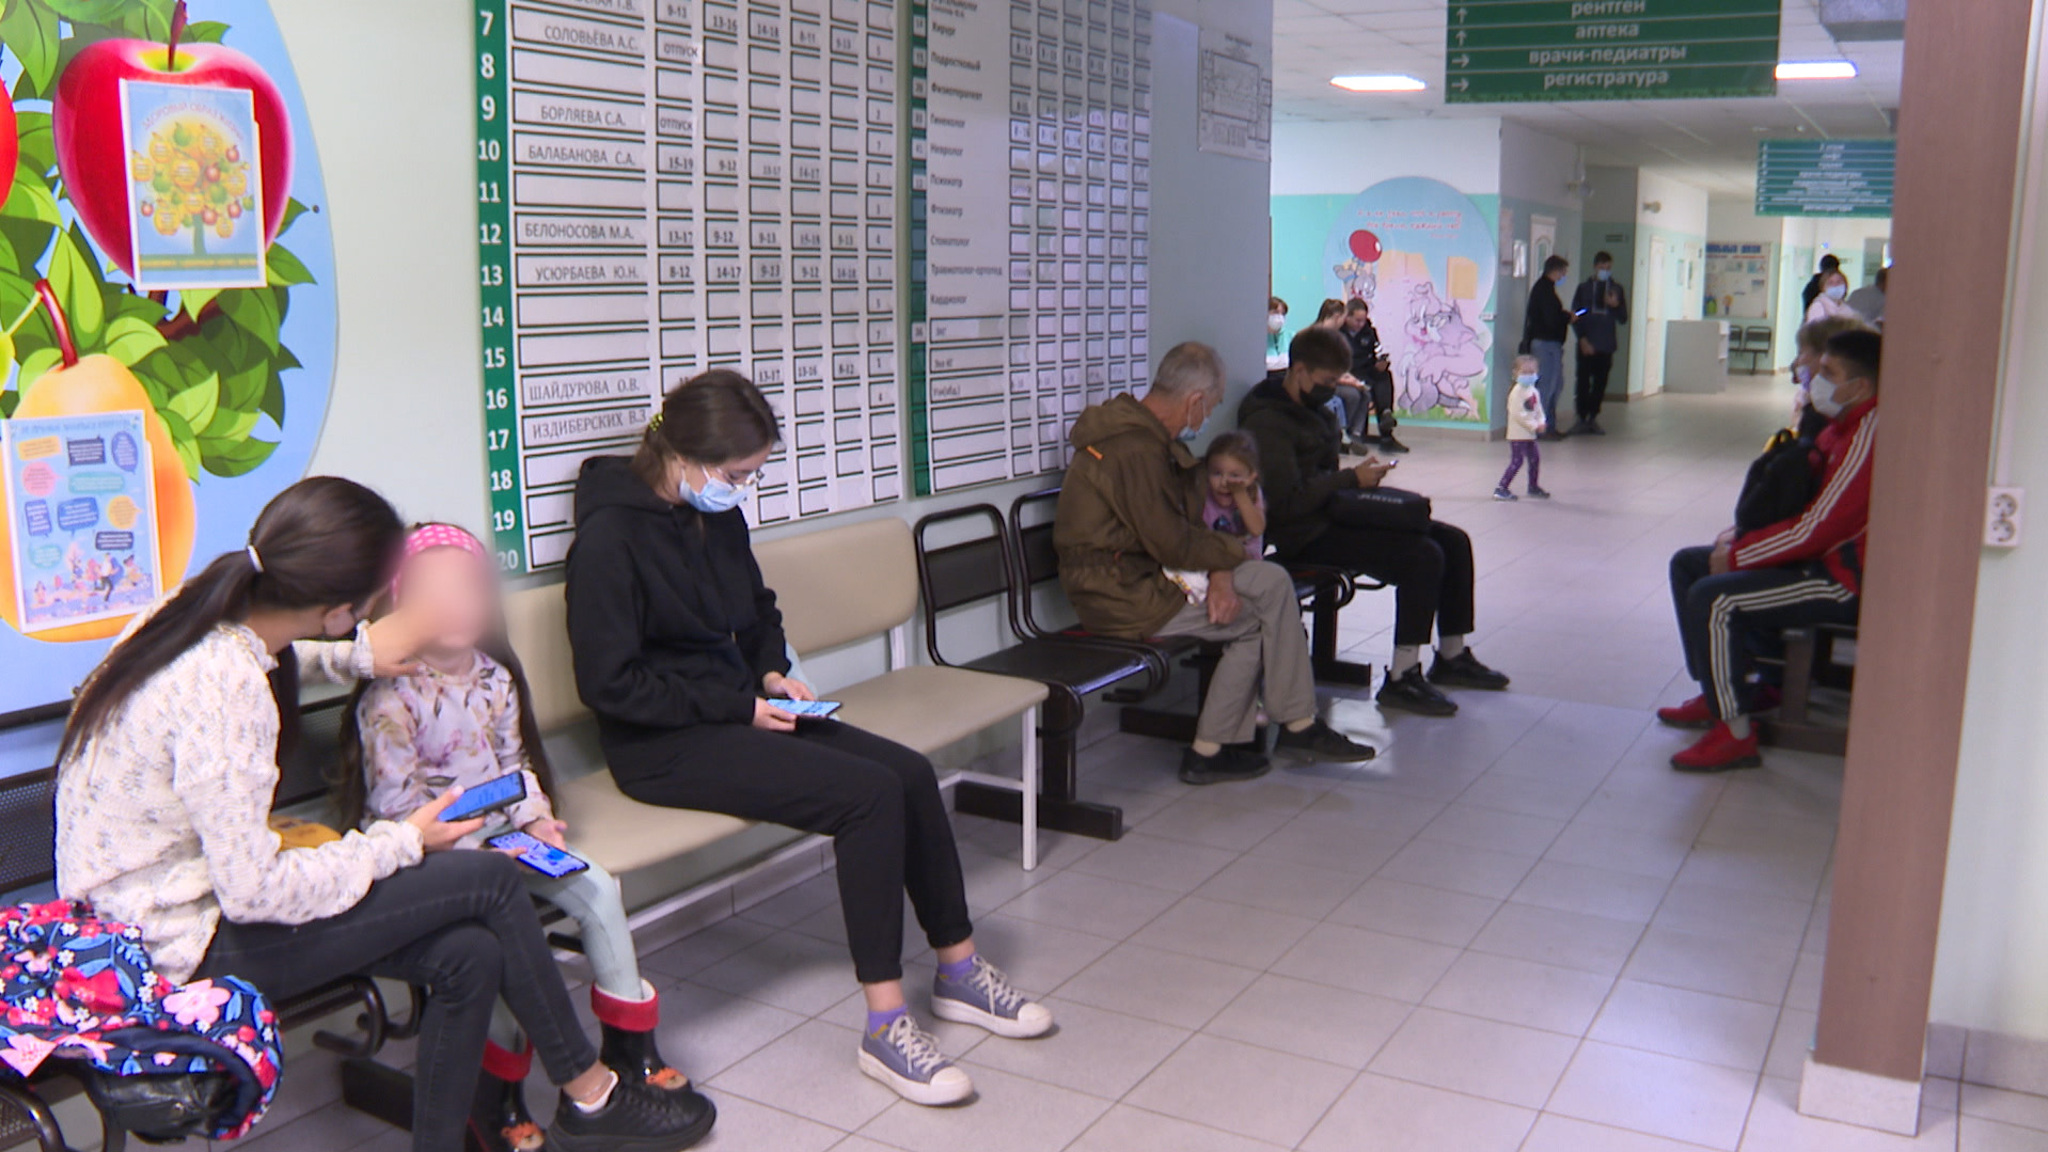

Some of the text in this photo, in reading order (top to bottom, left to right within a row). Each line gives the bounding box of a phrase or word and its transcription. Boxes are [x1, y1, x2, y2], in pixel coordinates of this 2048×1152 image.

[1570, 0, 1646, 18] рентген
[481, 10, 494, 36] 7
[1575, 22, 1640, 40] аптека
[545, 25, 639, 50] СОЛОВЬЁВА А.С.
[1529, 44, 1687, 66] врачи-педиатры
[481, 53, 495, 79] 8
[1544, 69, 1670, 91] регистратура
[481, 95, 496, 121] 9
[541, 105, 626, 126] БОРЛЯЕВА С.А.
[478, 140, 501, 161] 10
[528, 145, 636, 166] БАЛАБАНОВА С.А.
[479, 181, 501, 203] 11
[480, 223, 502, 244] 12
[525, 223, 634, 240] БЕЛОНОСОВА М.А.
[714, 231, 734, 243] 9-12
[481, 265, 503, 286] 13
[535, 265, 639, 281] УСЮРБАЕВА Ю.Н.
[670, 266, 691, 279] 8-12
[717, 266, 741, 279] 14-17
[483, 307, 504, 327] 14
[484, 349, 506, 368] 15
[486, 388, 508, 410] 16
[529, 378, 640, 401] ШАЙДУРОВА О.В.
[533, 413, 623, 440] ИЗДИБЕРСКИХ
[488, 429, 510, 451] 17
[491, 469, 513, 491] 18
[494, 510, 515, 532] 19
[498, 549, 519, 570] 20
